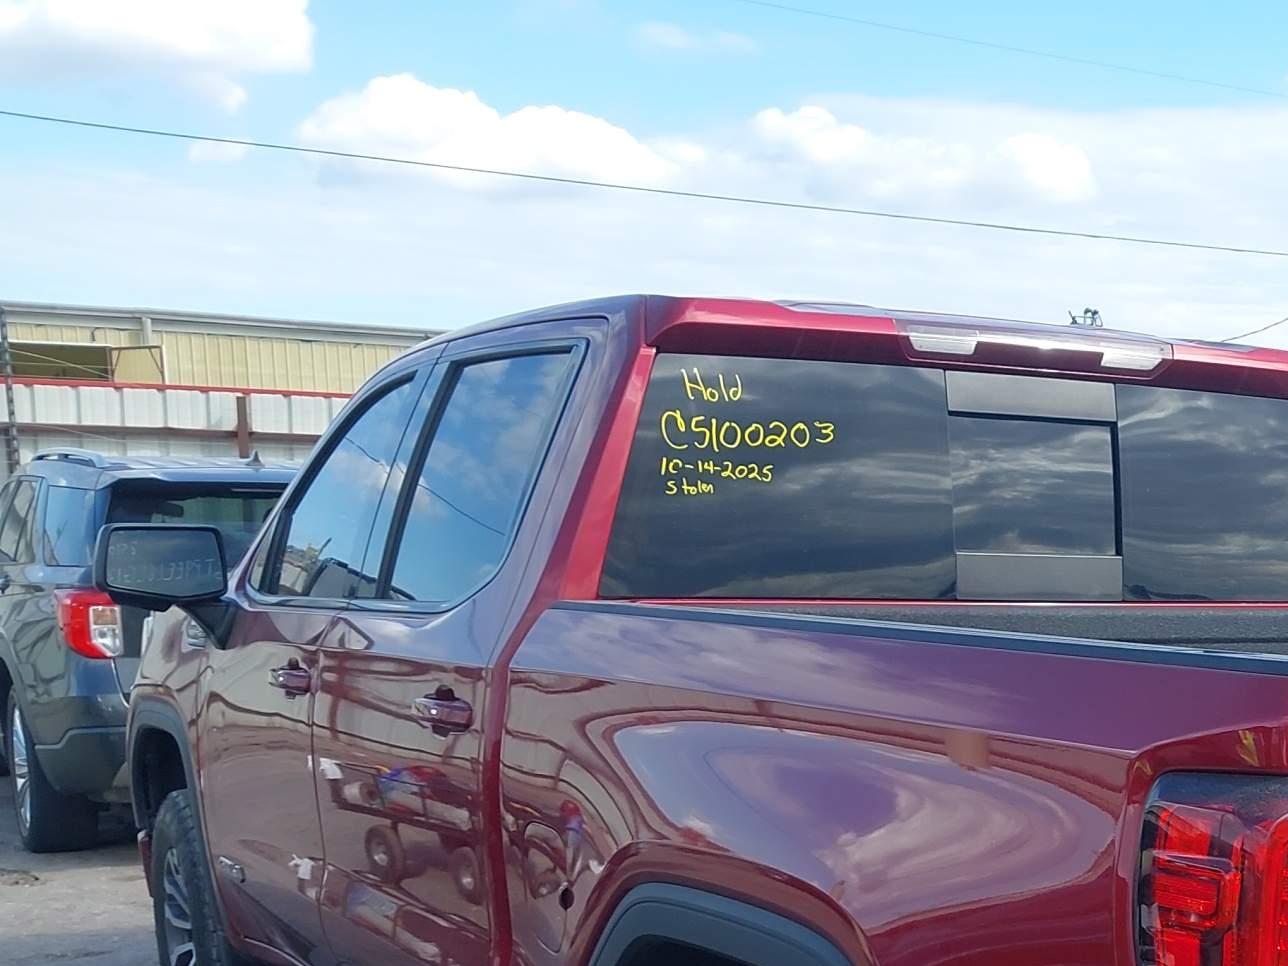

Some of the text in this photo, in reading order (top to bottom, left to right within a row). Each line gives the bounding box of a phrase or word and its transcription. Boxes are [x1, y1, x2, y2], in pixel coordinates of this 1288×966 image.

[681, 367, 743, 402] Hold
[660, 409, 835, 453] C5100203
[660, 457, 774, 482] 10-14-2025
